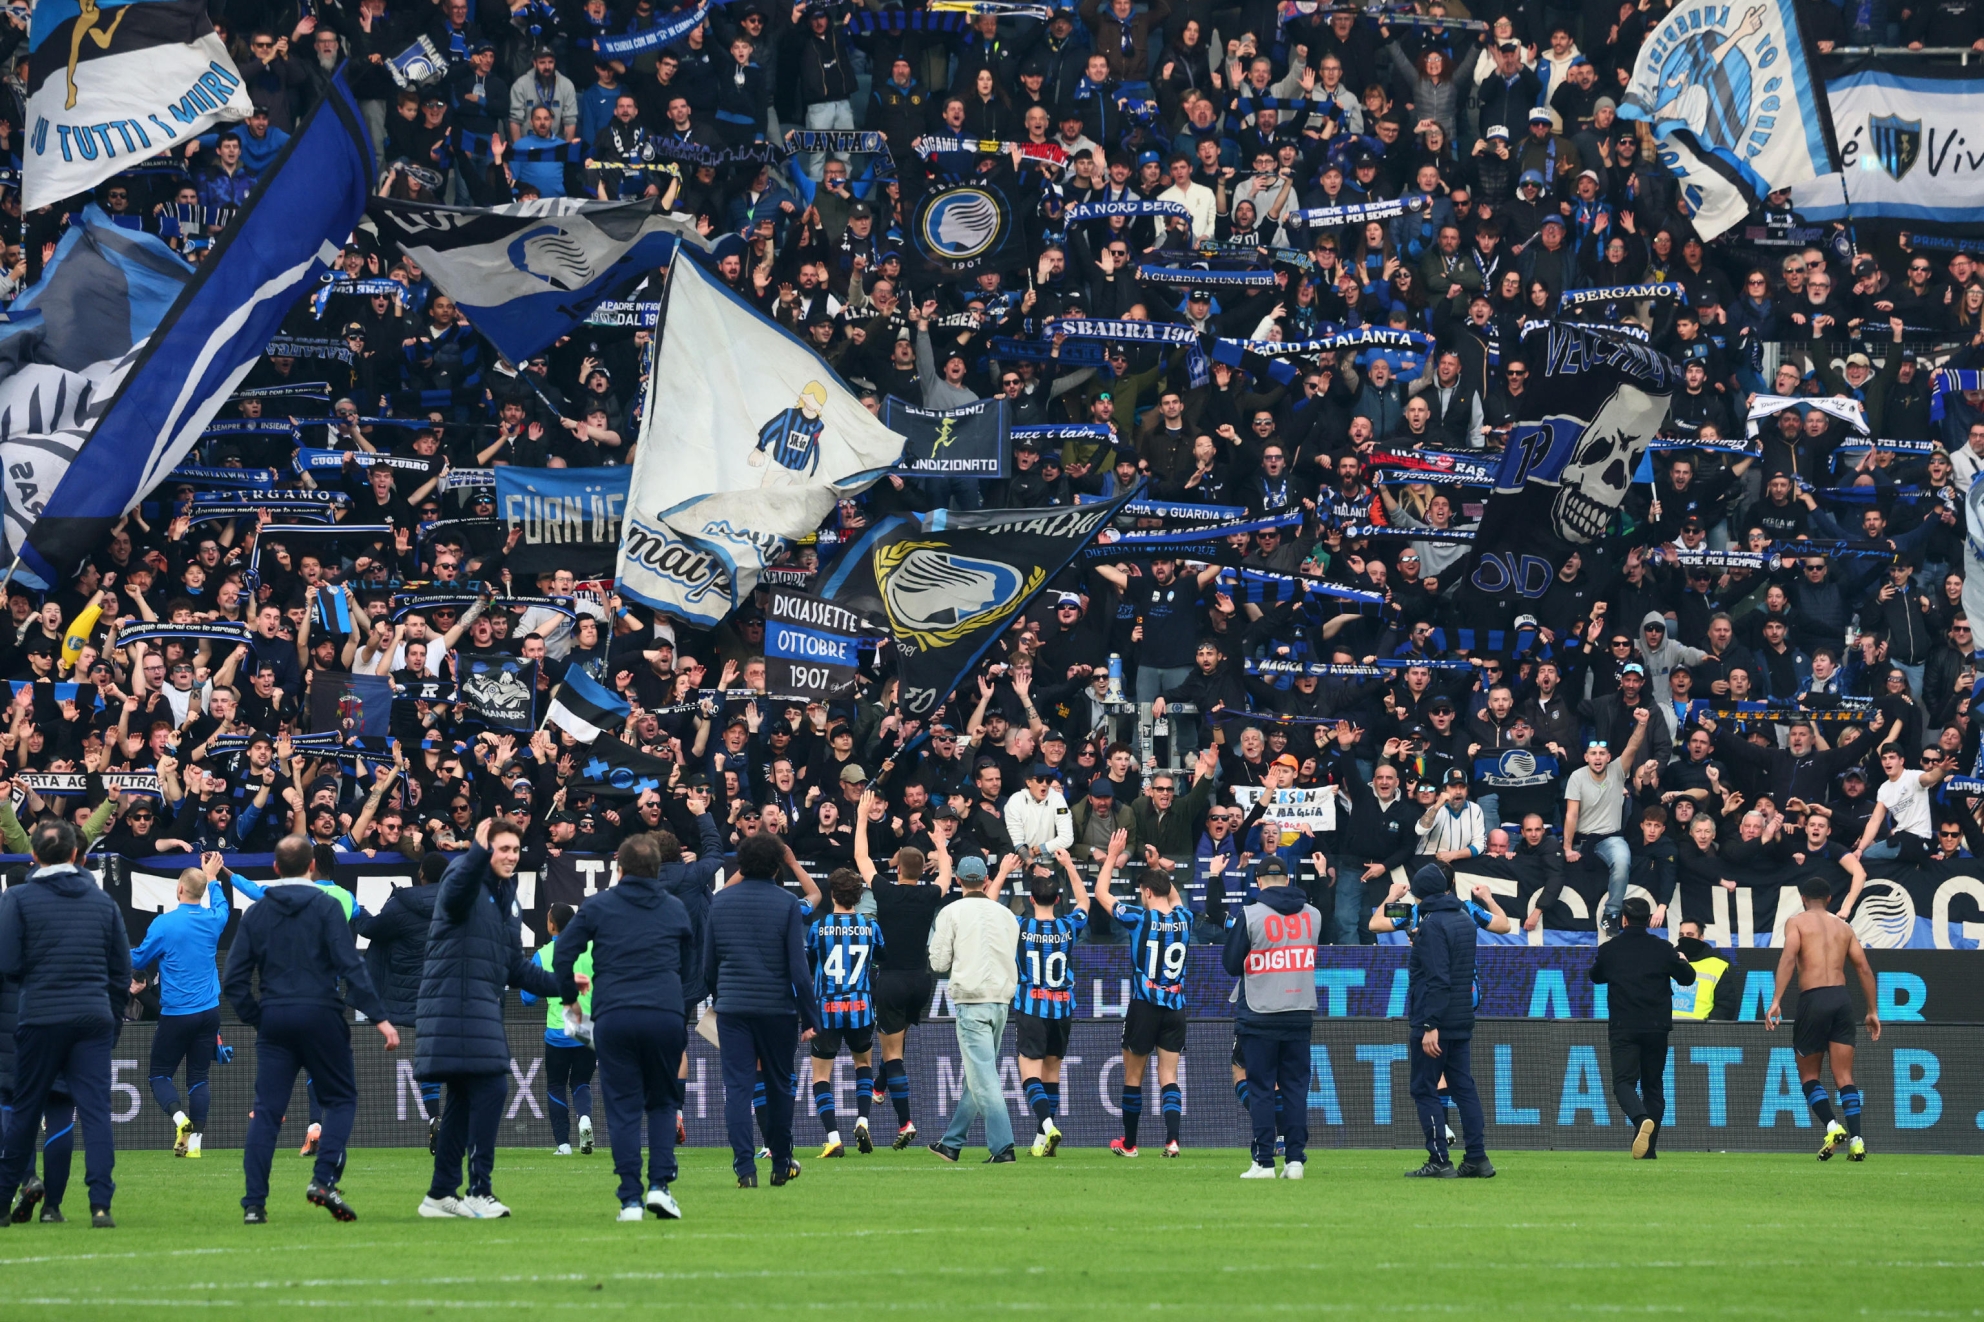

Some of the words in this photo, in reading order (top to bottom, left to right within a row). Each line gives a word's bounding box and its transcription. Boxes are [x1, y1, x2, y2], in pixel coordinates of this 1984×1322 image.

[57, 118, 152, 163] TUTTI
[147, 113, 177, 139] I
[928, 178, 989, 195] SBARRA
[1094, 203, 1138, 215] NORD
[1308, 206, 1343, 219] INSIEME
[1347, 203, 1361, 213] DA
[1364, 199, 1402, 211] SEMPRE
[1309, 213, 1345, 228] INSIEME
[1346, 210, 1365, 224] PER
[1366, 206, 1403, 220] SEMPRE
[951, 257, 983, 270] 1907
[1151, 273, 1202, 283] GUARDIA
[1219, 277, 1242, 285] UNA
[1245, 277, 1274, 287] FEDE
[1573, 285, 1672, 304] BERGAMO
[608, 301, 635, 311] PADRE
[636, 303, 645, 311] IN
[618, 313, 642, 326] DAL
[1062, 321, 1155, 340] SBARRA
[1308, 330, 1412, 351] ATALANTA
[212, 423, 241, 433] SEMPRE
[260, 423, 291, 432] INSIEME
[1877, 439, 1897, 448] PER
[1898, 440, 1913, 450] LA
[311, 456, 343, 466] CUOR
[1169, 507, 1220, 520] GUARDIA
[1705, 556, 1724, 566] PER
[1725, 557, 1762, 569] SEMPRE
[517, 596, 552, 604] saremo
[773, 594, 858, 633] DICIASSETTE
[119, 623, 156, 638] dovunque
[157, 623, 185, 631] andrai
[211, 626, 241, 635] saremo
[782, 630, 847, 660] OTTOBRE
[1257, 659, 1304, 673] MAGICA
[1330, 664, 1382, 675] ATALANTA
[794, 664, 830, 690] 1907
[481, 708, 526, 720] MANNERS
[1249, 789, 1317, 805] EERSON
[1258, 911, 1308, 944] 091
[823, 944, 869, 985] 47
[1146, 940, 1187, 980] 19
[1026, 950, 1067, 988] 10
[1029, 987, 1071, 1003] GEWISS
[1673, 997, 1691, 1009] 092
